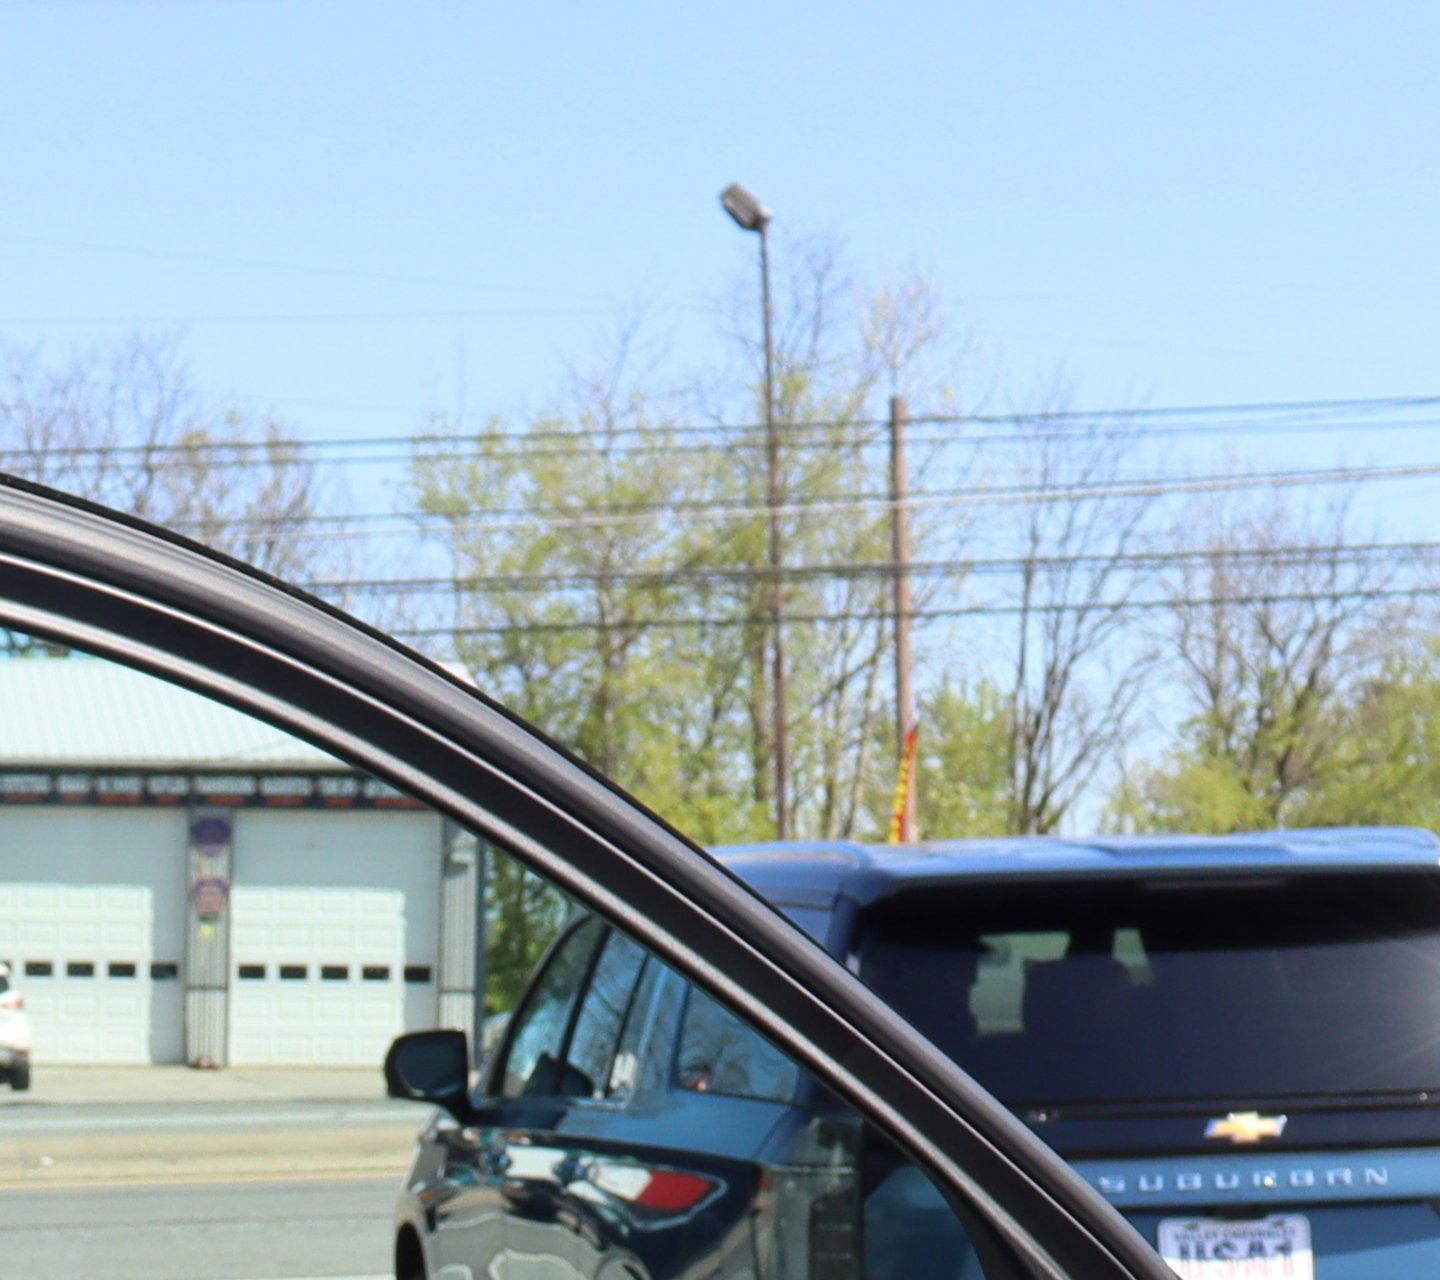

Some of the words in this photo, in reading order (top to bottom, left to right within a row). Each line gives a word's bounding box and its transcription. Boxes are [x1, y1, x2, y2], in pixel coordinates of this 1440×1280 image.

[1099, 1167, 1389, 1193] SUBURBAN
[1222, 1226, 1296, 1239] CHEVROLET
[1178, 1239, 1295, 1280] USA1
